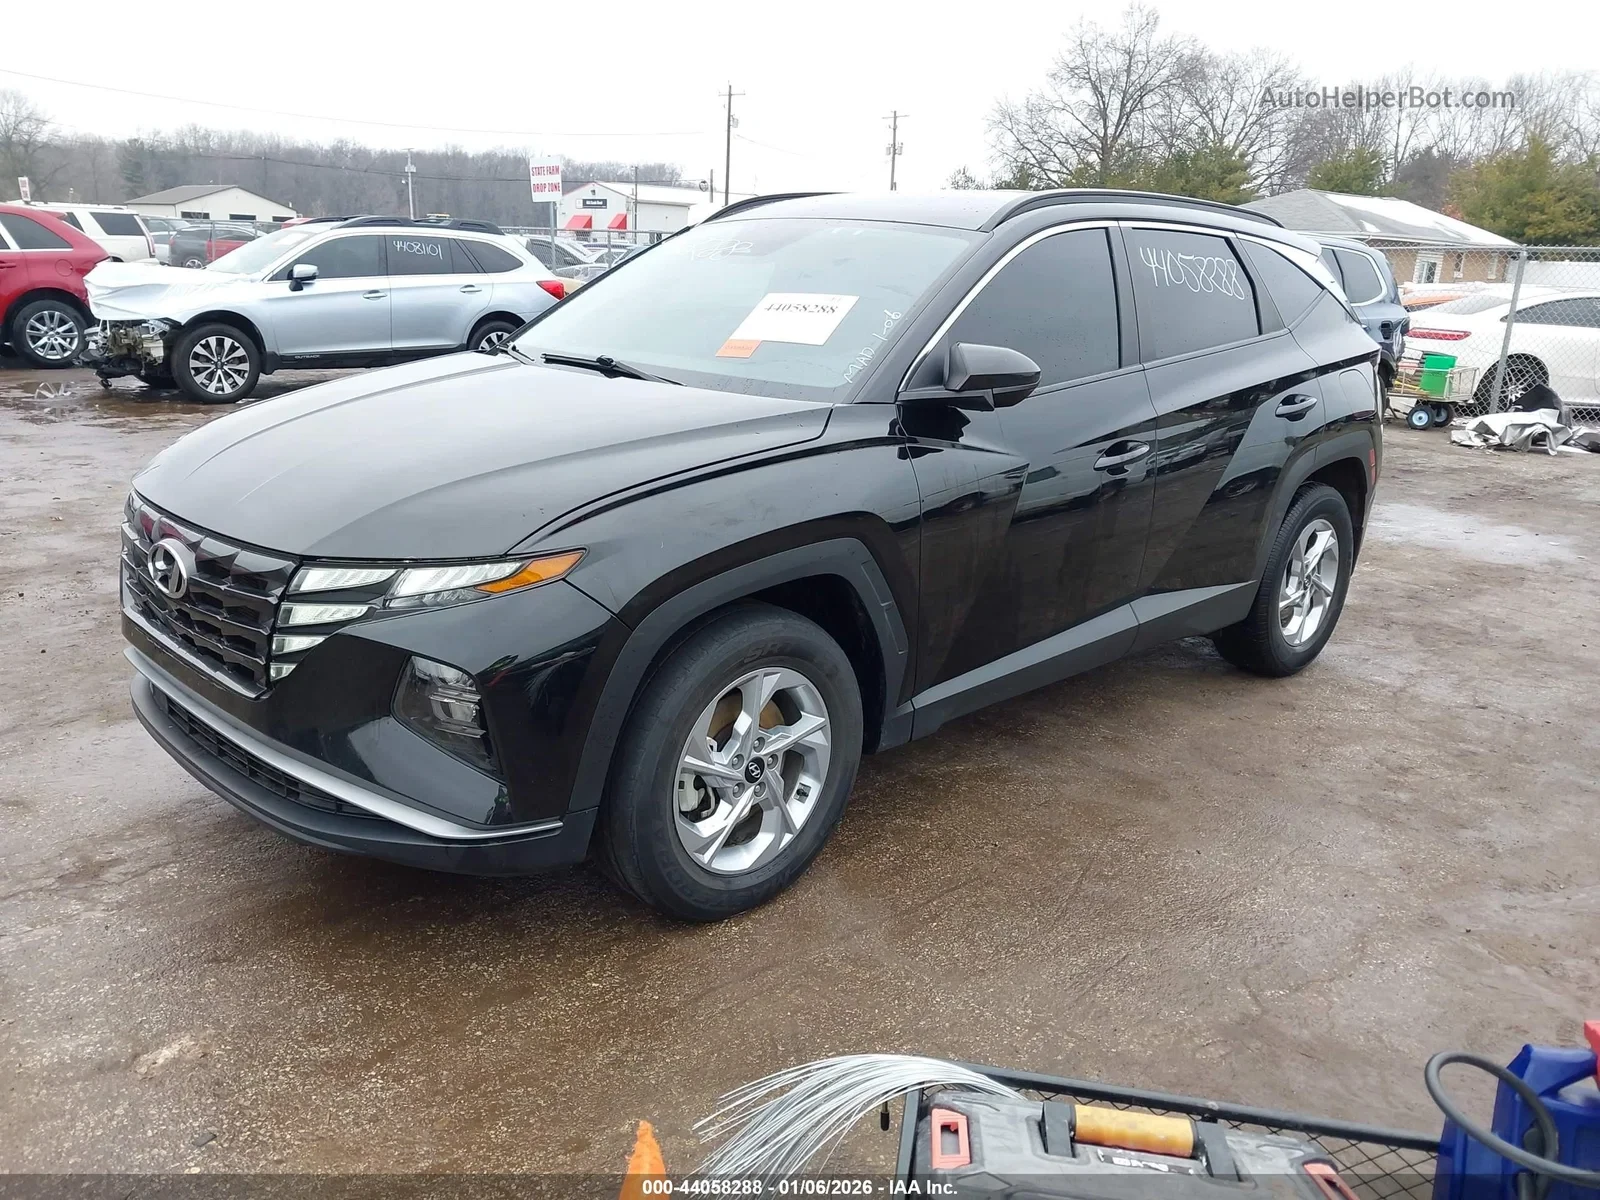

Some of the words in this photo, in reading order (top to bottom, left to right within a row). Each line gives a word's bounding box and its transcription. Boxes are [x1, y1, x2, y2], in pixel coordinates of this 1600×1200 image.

[531, 166, 545, 176] STATE
[546, 165, 559, 175] FARM
[533, 183, 546, 192] DROP
[548, 182, 560, 192] ZONE
[393, 240, 443, 260] 44081101
[764, 303, 838, 314] 44058288
